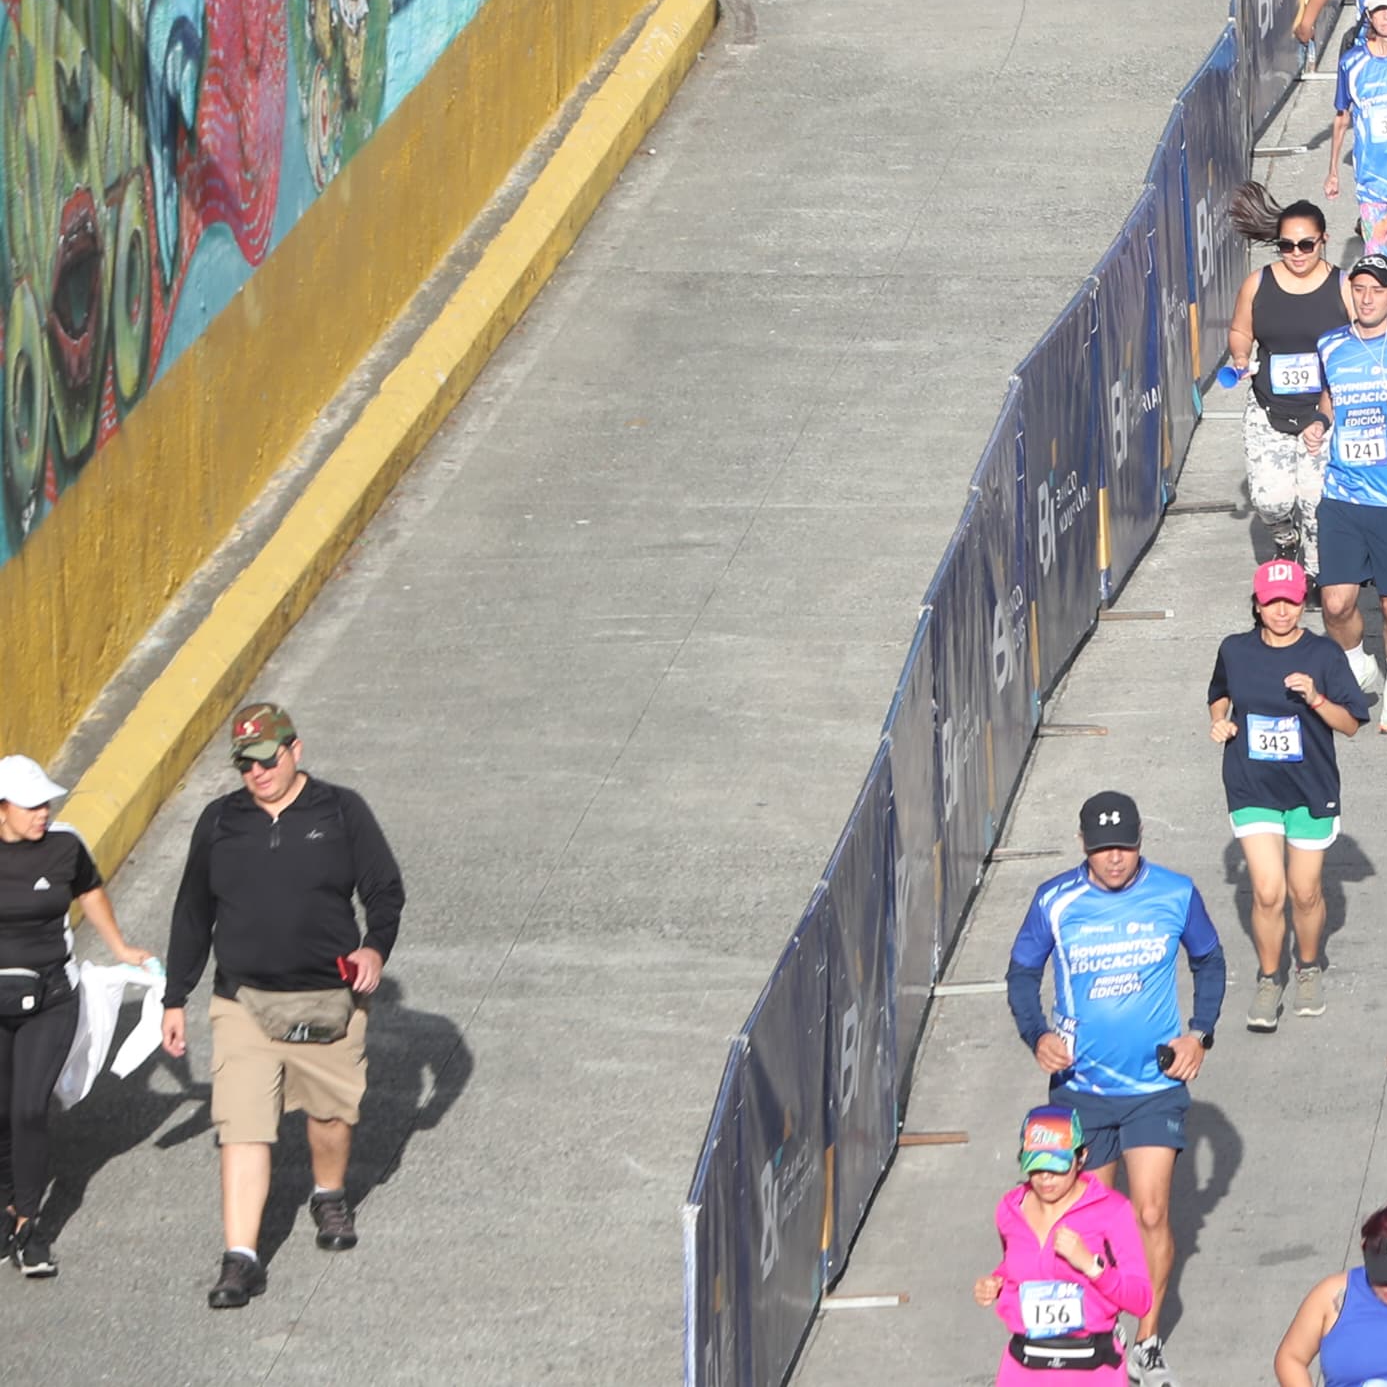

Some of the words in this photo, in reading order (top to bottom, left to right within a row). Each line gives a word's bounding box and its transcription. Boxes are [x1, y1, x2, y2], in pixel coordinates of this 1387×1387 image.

[1281, 370, 1309, 385] 339
[1344, 413, 1384, 427] EDICIÓN
[1344, 441, 1385, 460] 1241
[1258, 734, 1290, 752] 343
[1069, 940, 1151, 959] MOVIMIENTO
[1070, 951, 1163, 974] EDUCACIÓN
[1094, 973, 1139, 987] PRIMERA
[1089, 982, 1143, 999] EDICIÓN
[1034, 1304, 1071, 1324] 156
